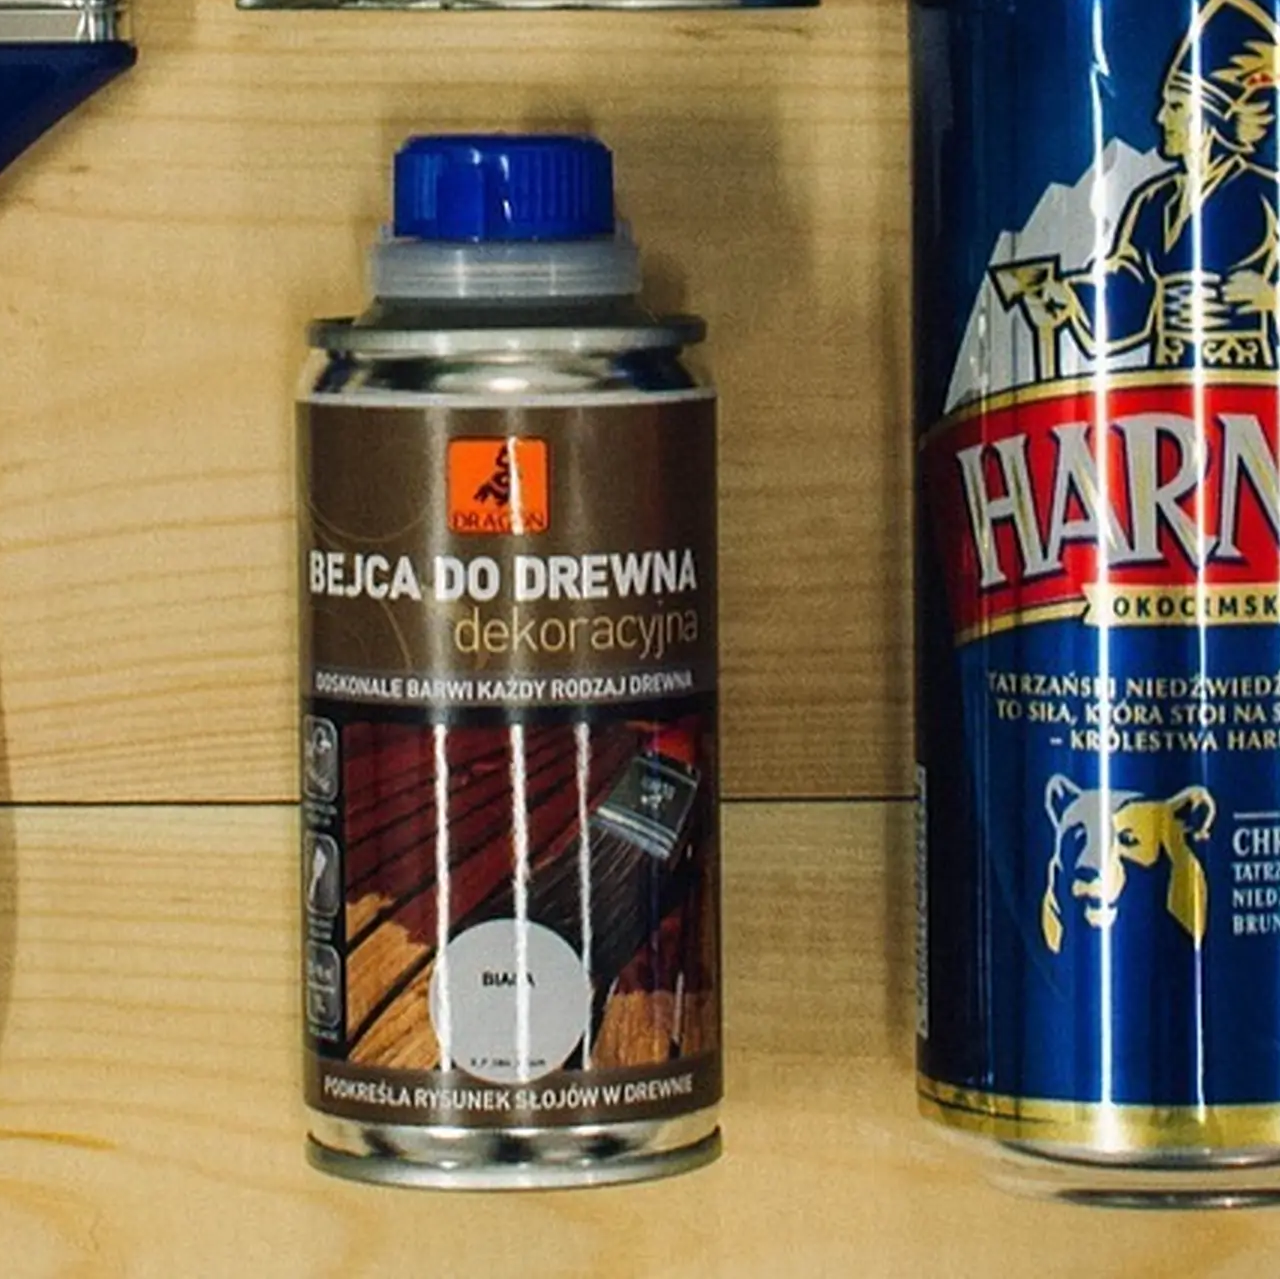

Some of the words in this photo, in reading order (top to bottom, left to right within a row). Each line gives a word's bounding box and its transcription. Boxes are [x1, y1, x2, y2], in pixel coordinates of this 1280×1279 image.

[309, 549, 422, 602] BEJCA
[433, 555, 501, 602] DO
[514, 548, 698, 602] DREWNA
[454, 601, 699, 660] dekoracyjna
[316, 671, 405, 698] DOSKONALE
[406, 677, 474, 700] BARWI
[476, 675, 548, 700] KAŻDY
[550, 676, 626, 700] RODZAJ
[629, 670, 694, 695] DREWNA
[996, 698, 1023, 720] TO
[1028, 701, 1078, 726] SIŁA,
[1169, 702, 1226, 726] STOI
[1233, 702, 1266, 722] NA
[1071, 726, 1219, 752] KRÓLESTWA
[323, 1074, 412, 1108] PODKREŚLA
[413, 1086, 512, 1111] RYSUNEK
[514, 1081, 601, 1111] SŁOJÓW
[602, 1086, 622, 1106] W
[623, 1072, 695, 1104] DREWNIE
